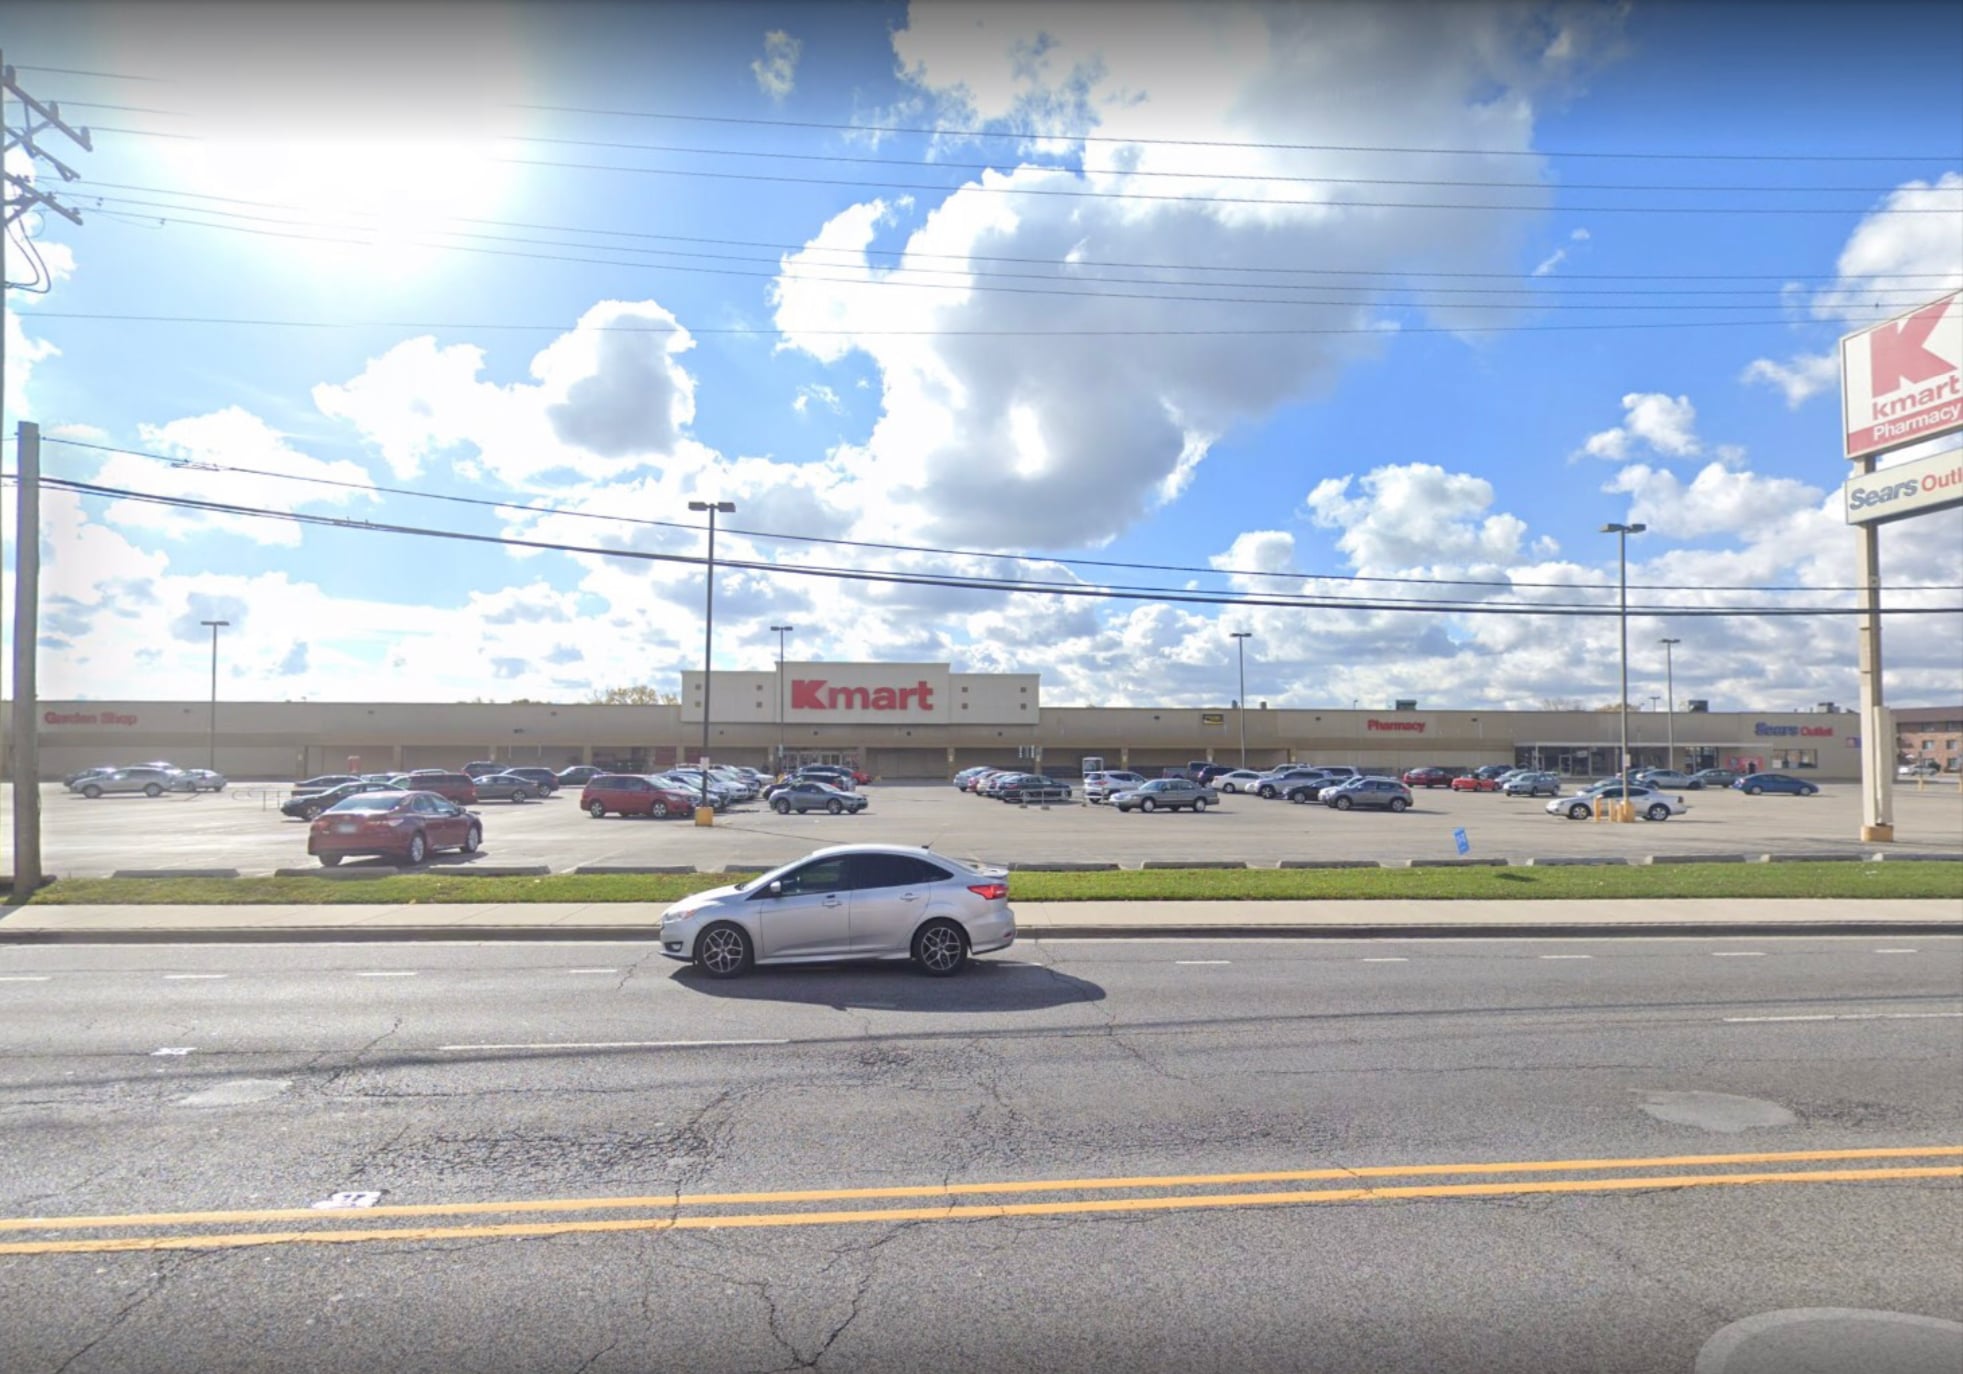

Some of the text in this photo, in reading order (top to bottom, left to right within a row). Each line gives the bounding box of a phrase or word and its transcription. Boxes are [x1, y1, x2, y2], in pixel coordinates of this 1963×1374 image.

[1873, 403, 1962, 441] Pharmacy
[1849, 479, 1919, 511] Sears
[791, 679, 935, 711] Kmart
[101, 712, 137, 726] Shop
[1367, 719, 1426, 733] Pharmacy
[1755, 722, 1798, 736] Sears
